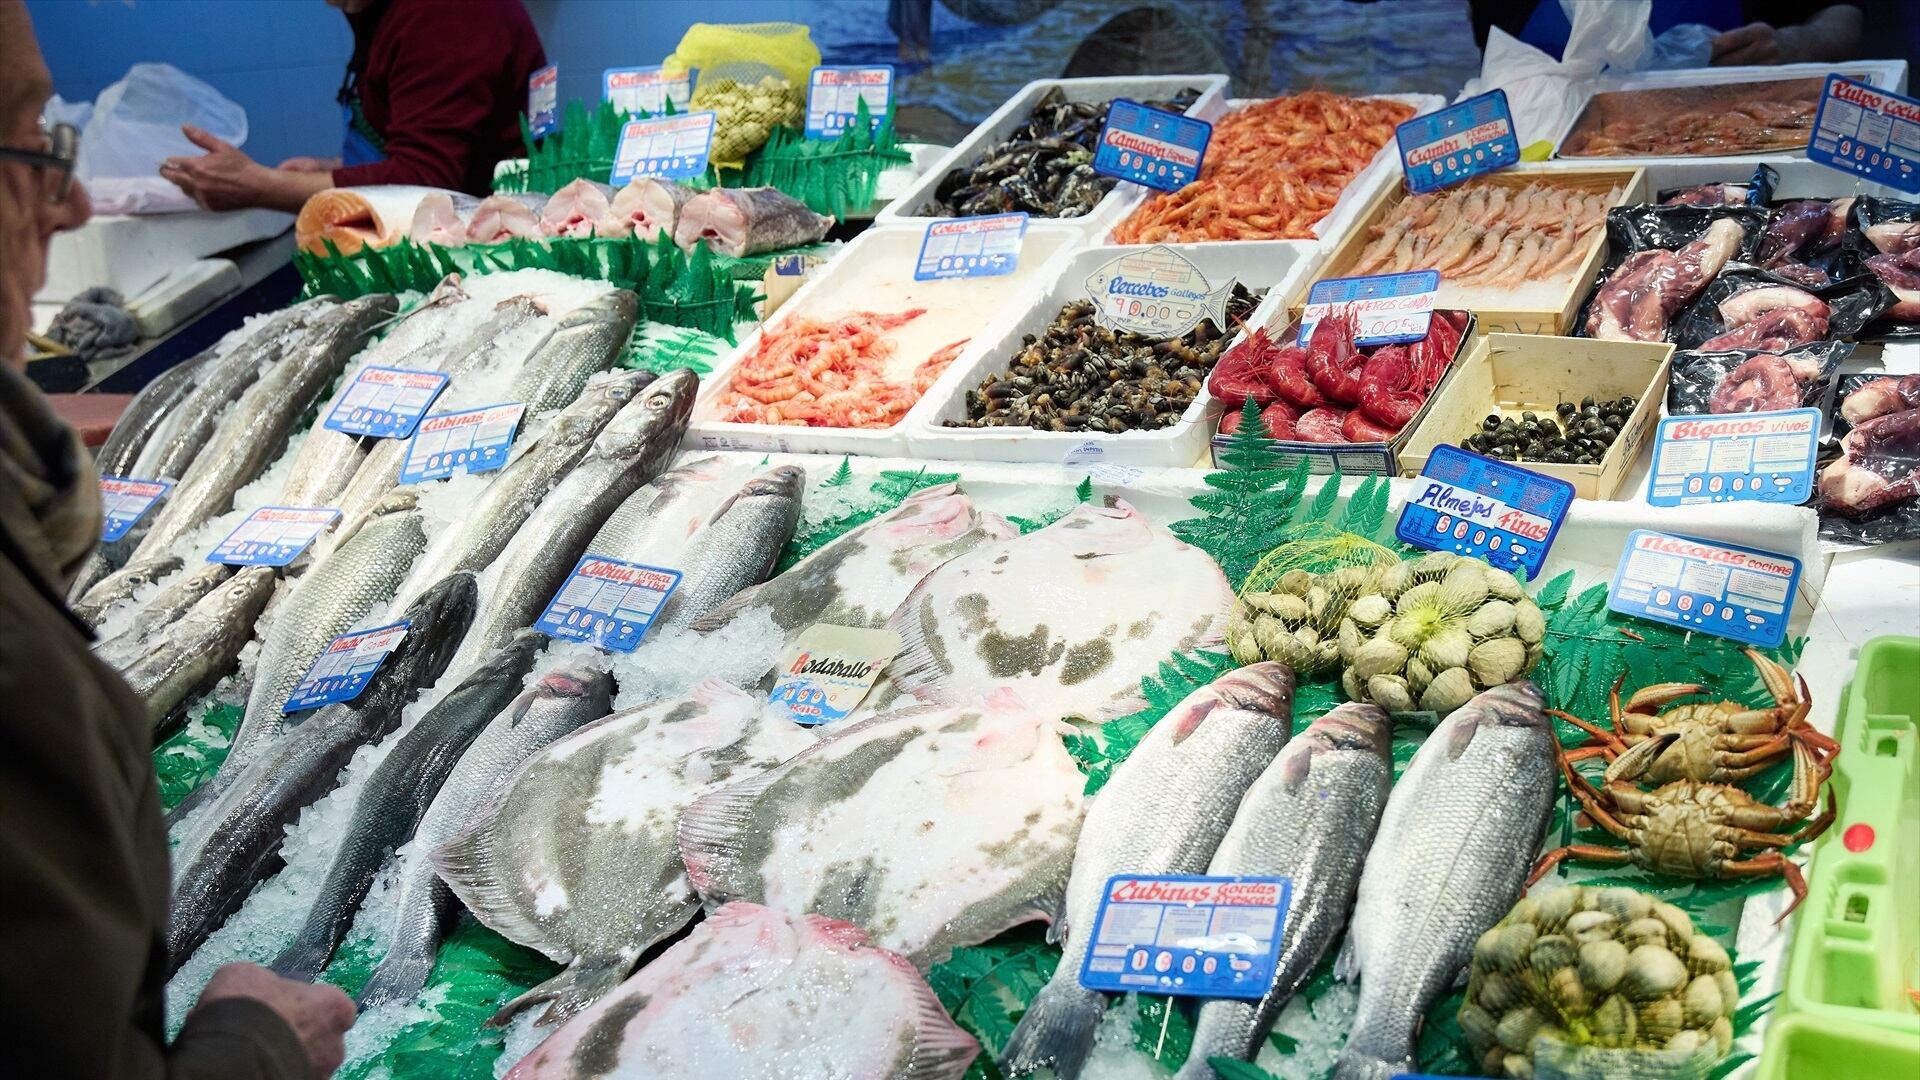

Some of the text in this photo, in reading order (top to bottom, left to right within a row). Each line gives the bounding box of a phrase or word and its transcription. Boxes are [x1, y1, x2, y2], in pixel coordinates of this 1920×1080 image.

[1833, 80, 1882, 108] Pulpo
[1416, 484, 1495, 518] Almejas
[790, 651, 871, 678] Rodaballo
[1216, 883, 1276, 894] Gordas
